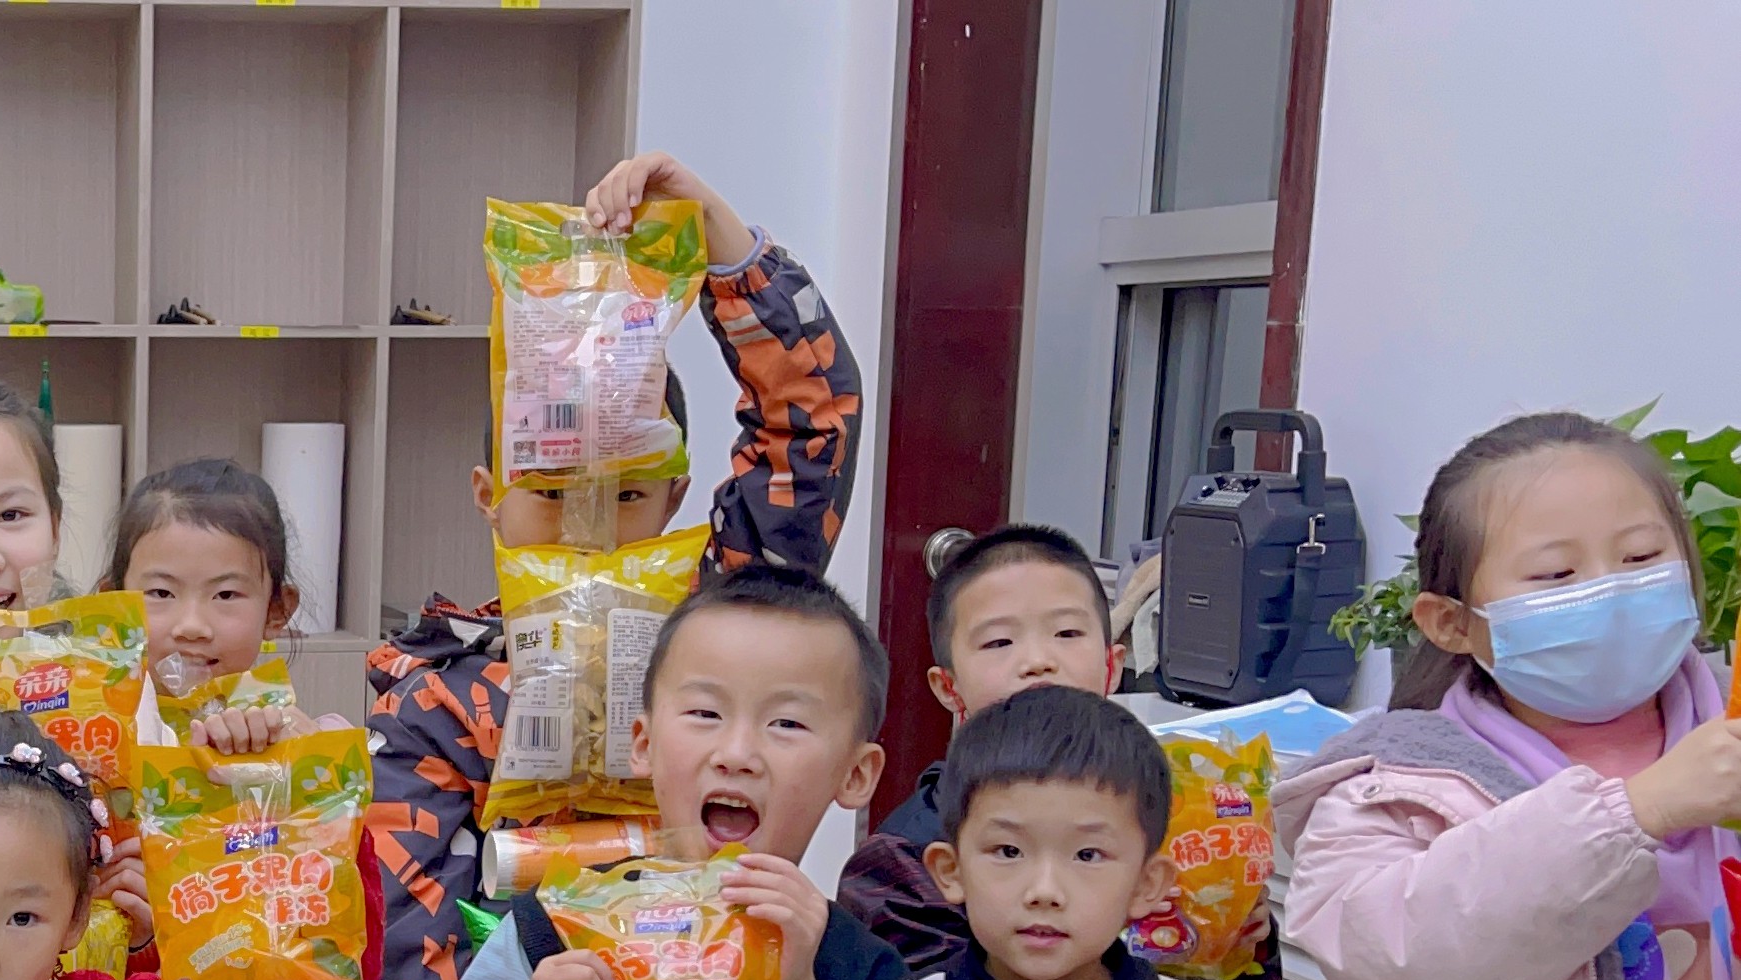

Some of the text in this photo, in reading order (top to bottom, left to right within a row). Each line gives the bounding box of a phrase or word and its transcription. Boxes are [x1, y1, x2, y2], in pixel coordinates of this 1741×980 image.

[17, 669, 71, 697] 亲亲
[45, 714, 120, 753] 果肉
[169, 850, 334, 923] 橘子果肉
